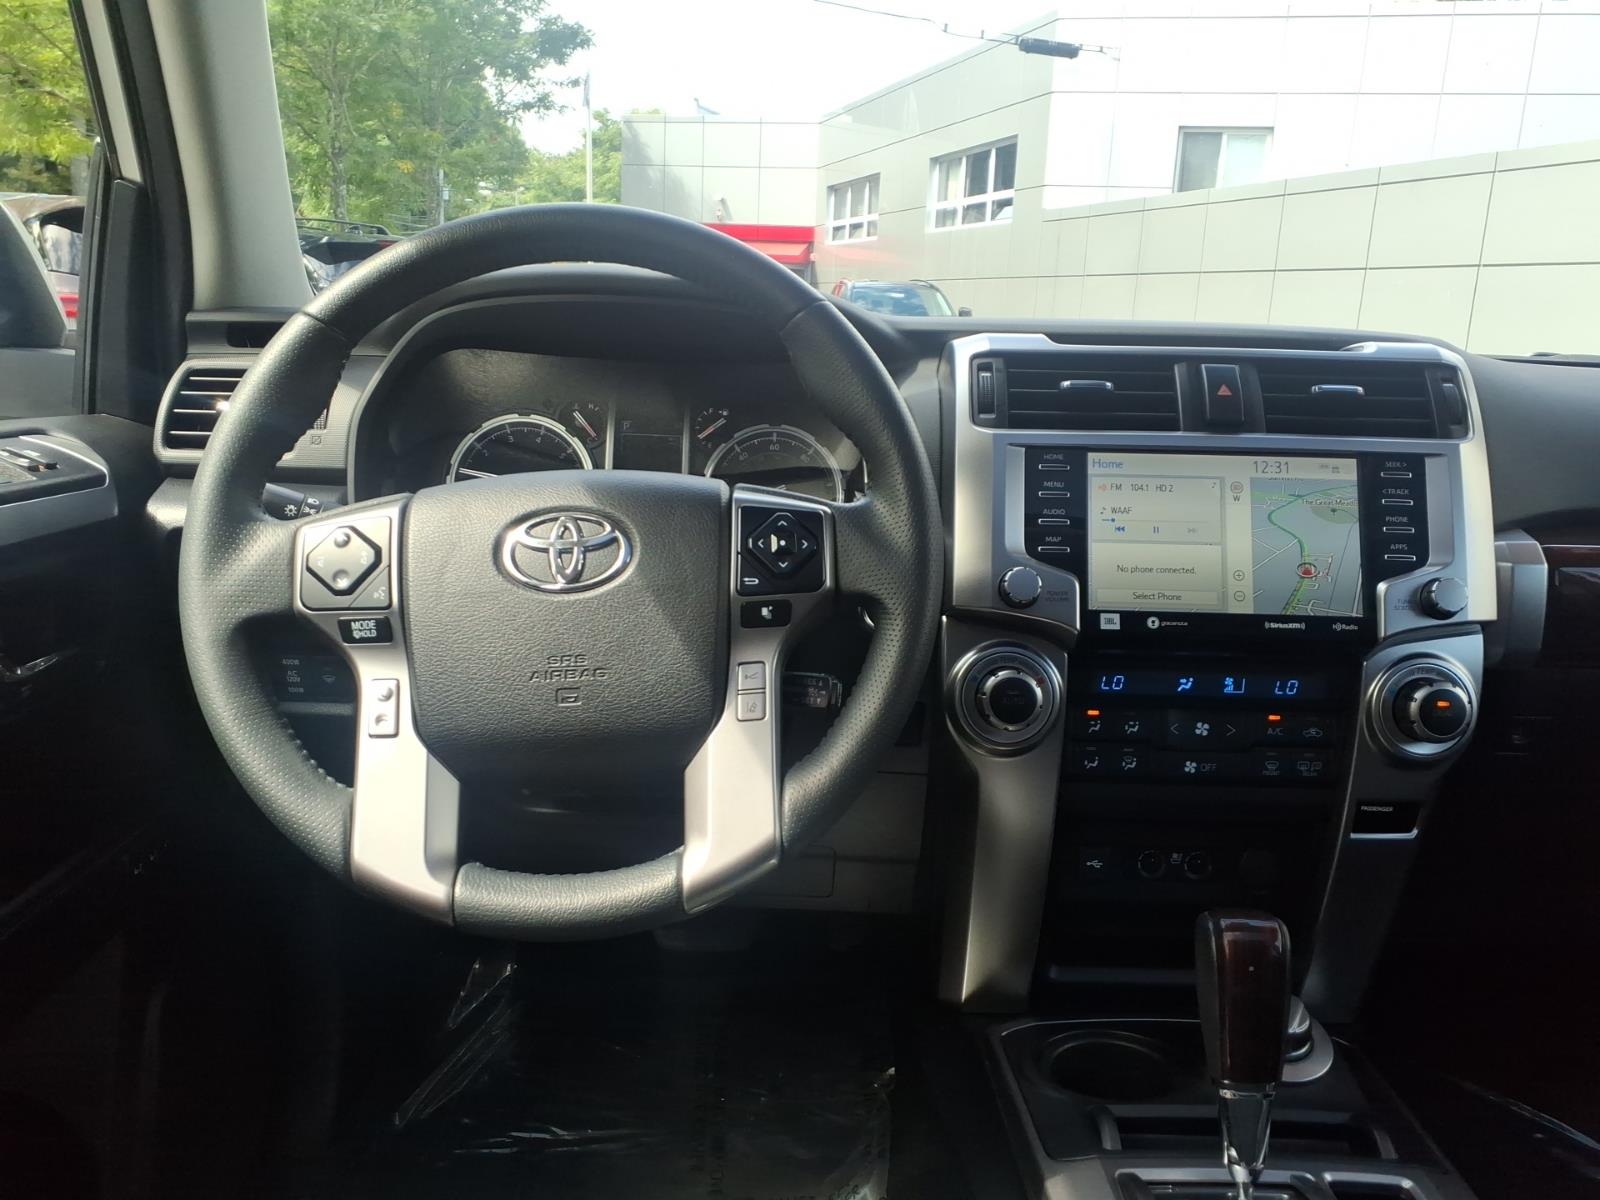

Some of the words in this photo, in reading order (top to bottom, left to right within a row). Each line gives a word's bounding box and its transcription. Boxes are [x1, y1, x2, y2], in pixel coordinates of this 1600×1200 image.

[769, 443, 780, 451] 60
[1092, 458, 1124, 470] Home
[1253, 460, 1290, 474] 12:31
[1110, 483, 1123, 491] FM
[1130, 483, 1150, 492] 104.1
[1156, 484, 1167, 493] HD
[1232, 494, 1241, 502] W
[1043, 508, 1066, 516] AUDIO
[1110, 506, 1133, 514] WAAF
[1117, 564, 1129, 573] No
[1130, 564, 1154, 576] phone
[1155, 565, 1197, 575] connected.
[1132, 591, 1157, 601] Select
[1157, 592, 1183, 602] Phone
[351, 620, 377, 631] MODE
[360, 629, 378, 638] HOLD
[549, 654, 588, 669] SRS
[528, 668, 610, 684] AIRBAG
[1267, 727, 1284, 736] A/C
[1200, 763, 1217, 772] OFF
